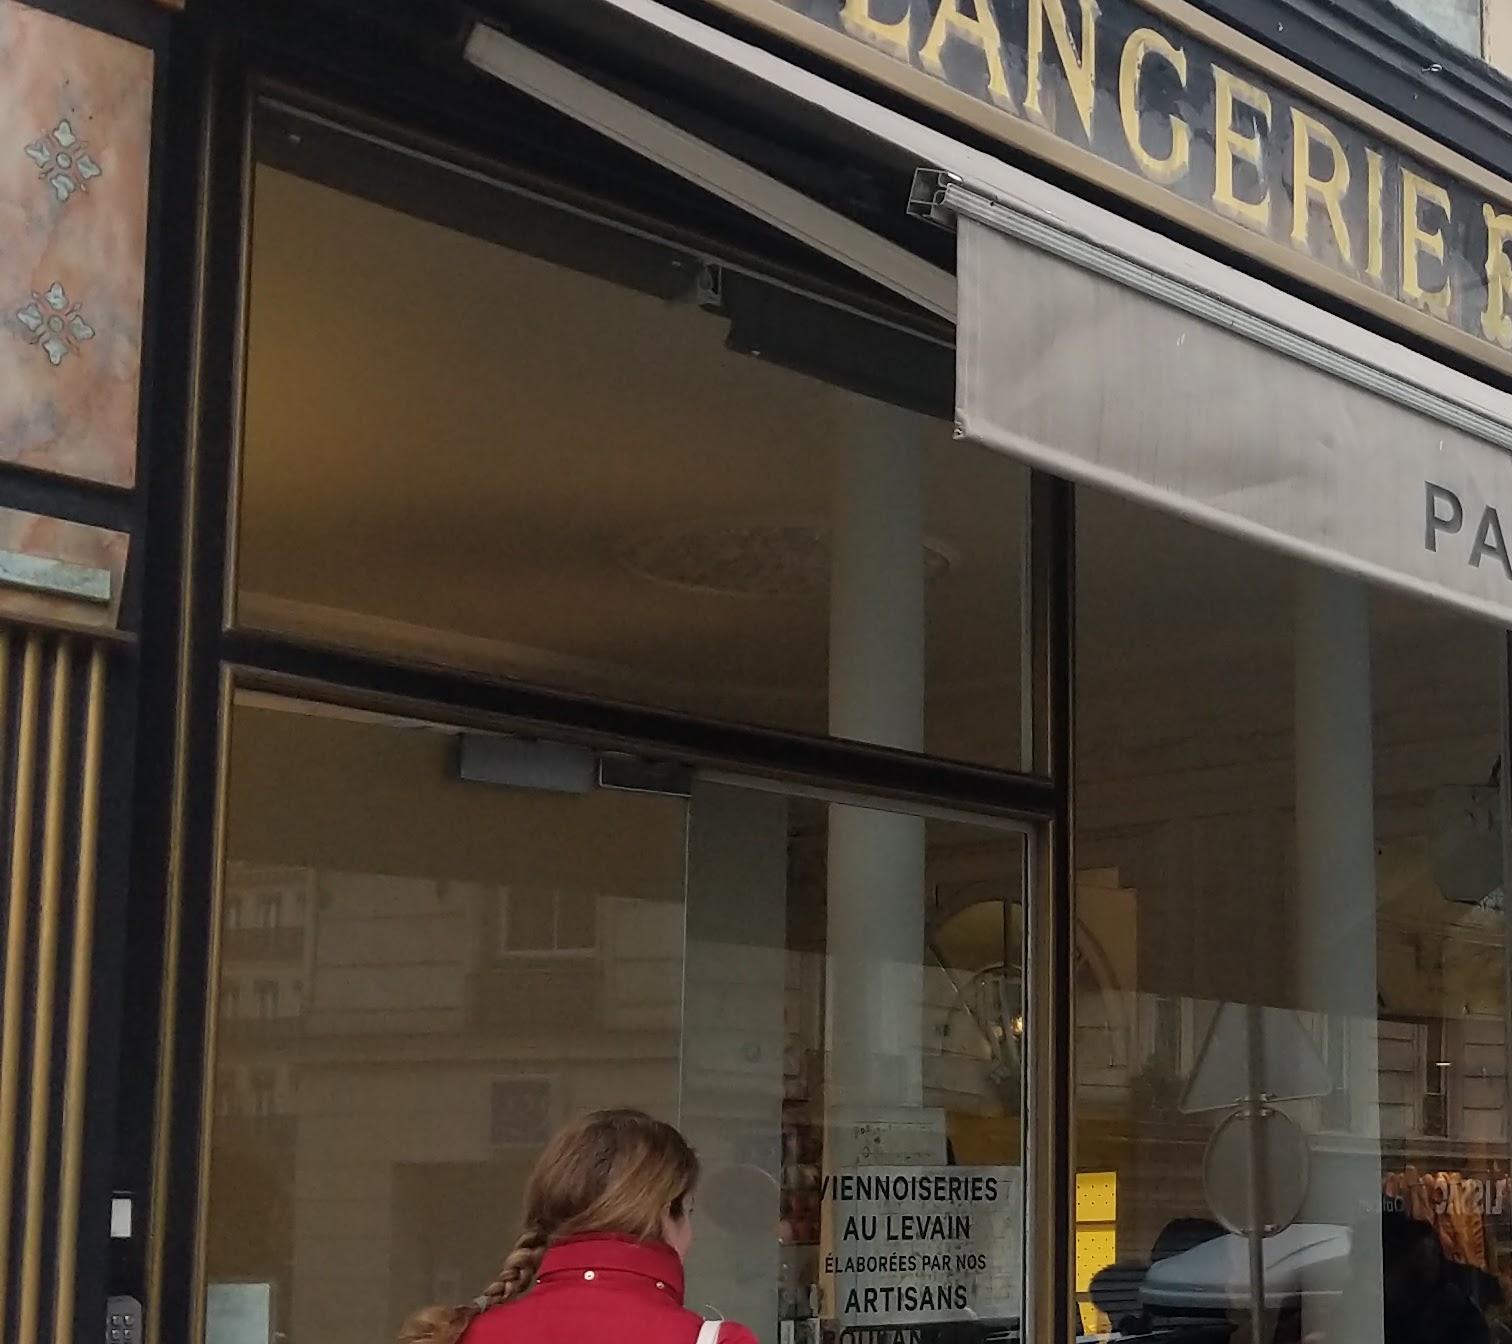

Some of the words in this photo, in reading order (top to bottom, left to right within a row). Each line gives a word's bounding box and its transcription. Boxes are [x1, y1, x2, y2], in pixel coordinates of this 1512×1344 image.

[819, 1174, 998, 1202] VIENNOISERIES
[843, 1215, 877, 1241] AU
[886, 1215, 971, 1240] LEVAIN
[824, 1252, 917, 1274] ÉLABORÉES
[922, 1254, 951, 1272] PAR
[956, 1253, 987, 1271] NOS
[844, 1285, 968, 1313] ARTISANS
